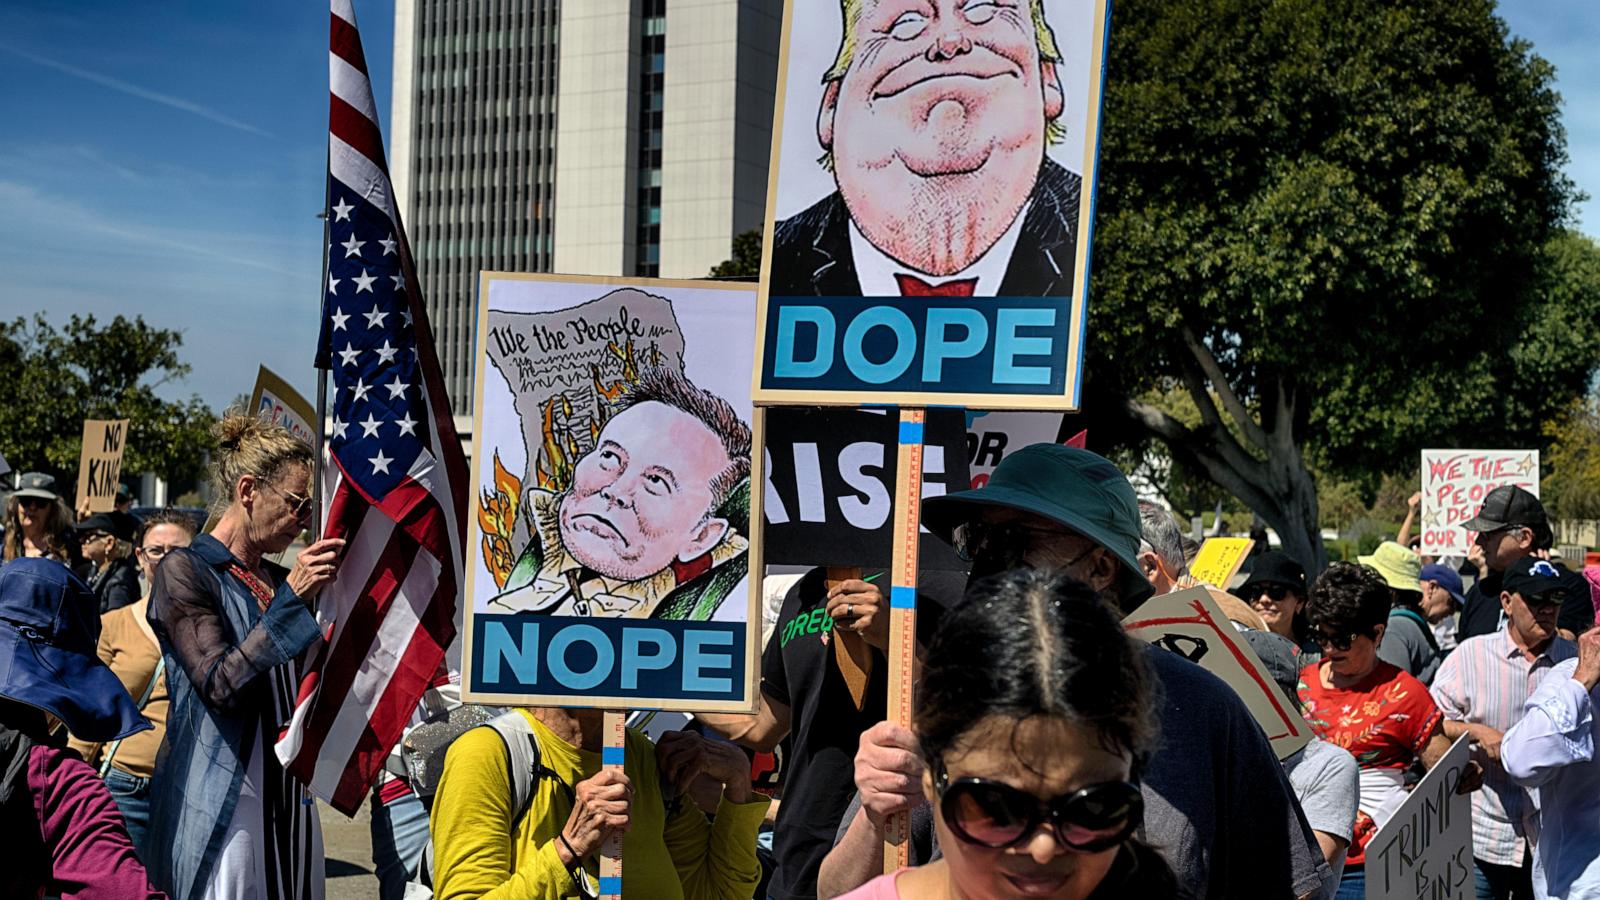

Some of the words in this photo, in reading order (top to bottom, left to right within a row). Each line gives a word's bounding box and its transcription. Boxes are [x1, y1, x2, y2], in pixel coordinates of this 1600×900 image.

[488, 324, 530, 358] We
[533, 323, 569, 353] the
[566, 305, 645, 345] People
[774, 305, 1057, 385] DOPE
[103, 422, 122, 453] NO
[1427, 454, 1468, 486] WE
[1468, 456, 1524, 480] THE
[1424, 530, 1456, 548] OUR
[481, 620, 734, 693] NOPE
[1378, 766, 1459, 894] TRUMP
[1415, 859, 1429, 896] IS
